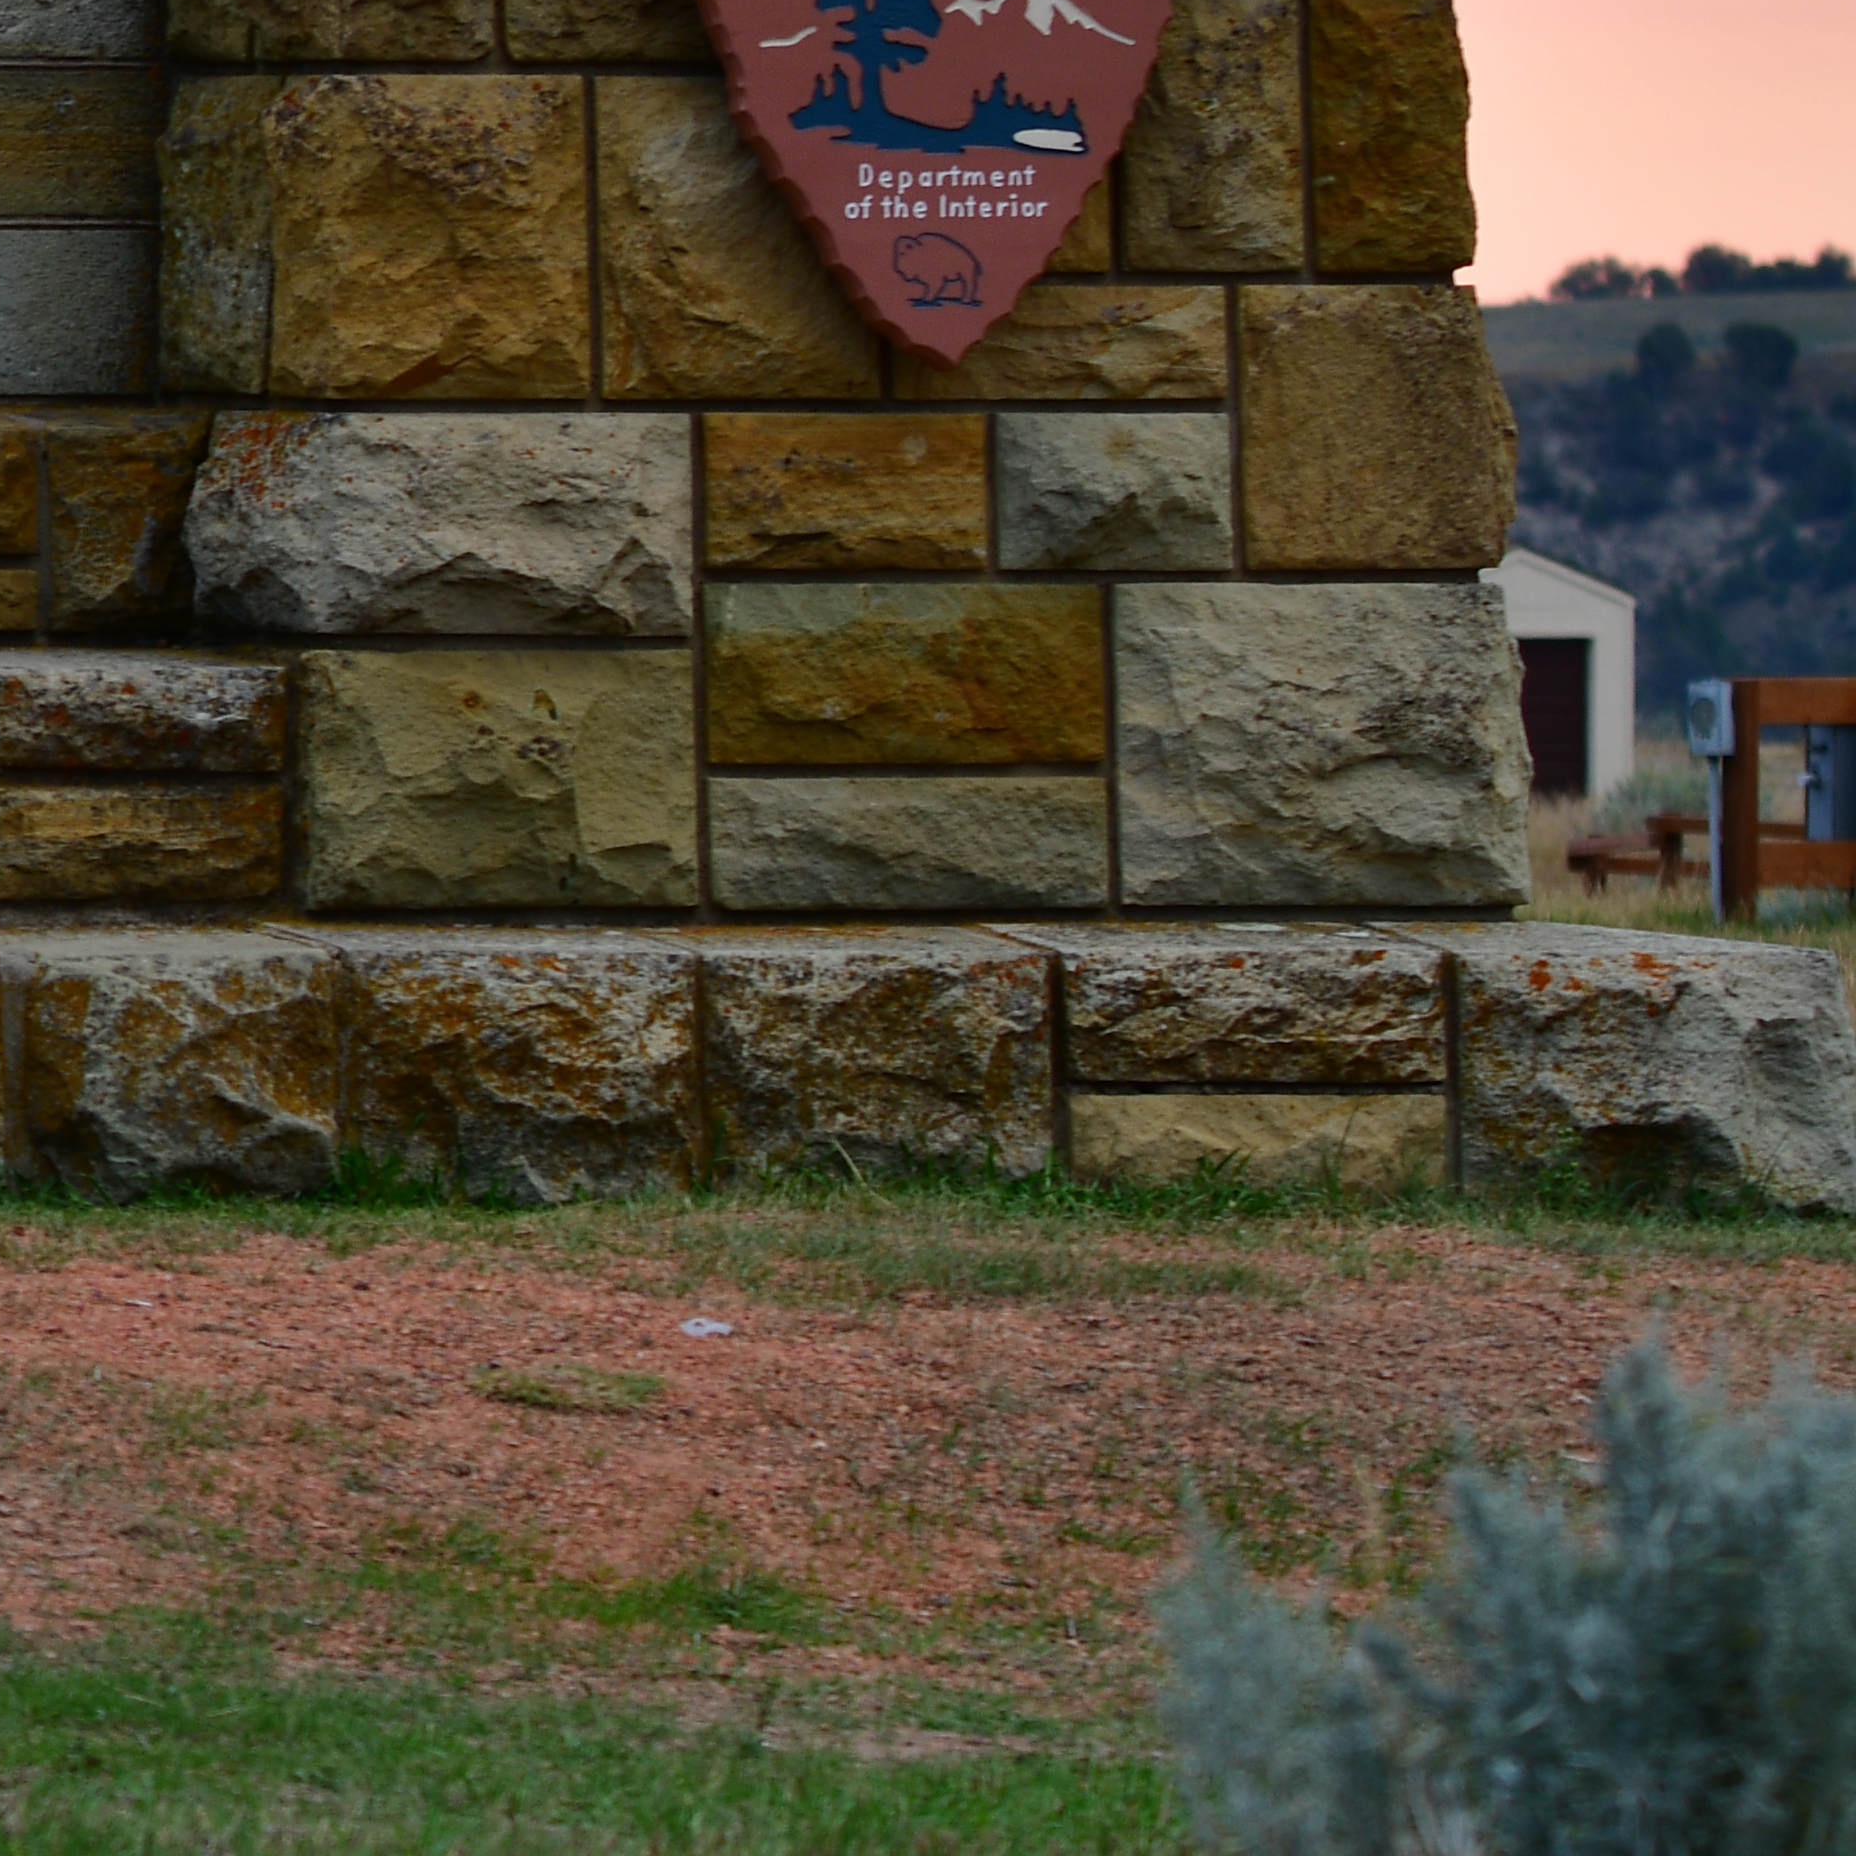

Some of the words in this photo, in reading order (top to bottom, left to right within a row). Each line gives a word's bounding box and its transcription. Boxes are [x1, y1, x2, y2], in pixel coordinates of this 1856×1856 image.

[858, 162, 1036, 193] Department
[844, 194, 872, 220] of
[880, 194, 928, 220] the
[938, 195, 1049, 219] Interior
